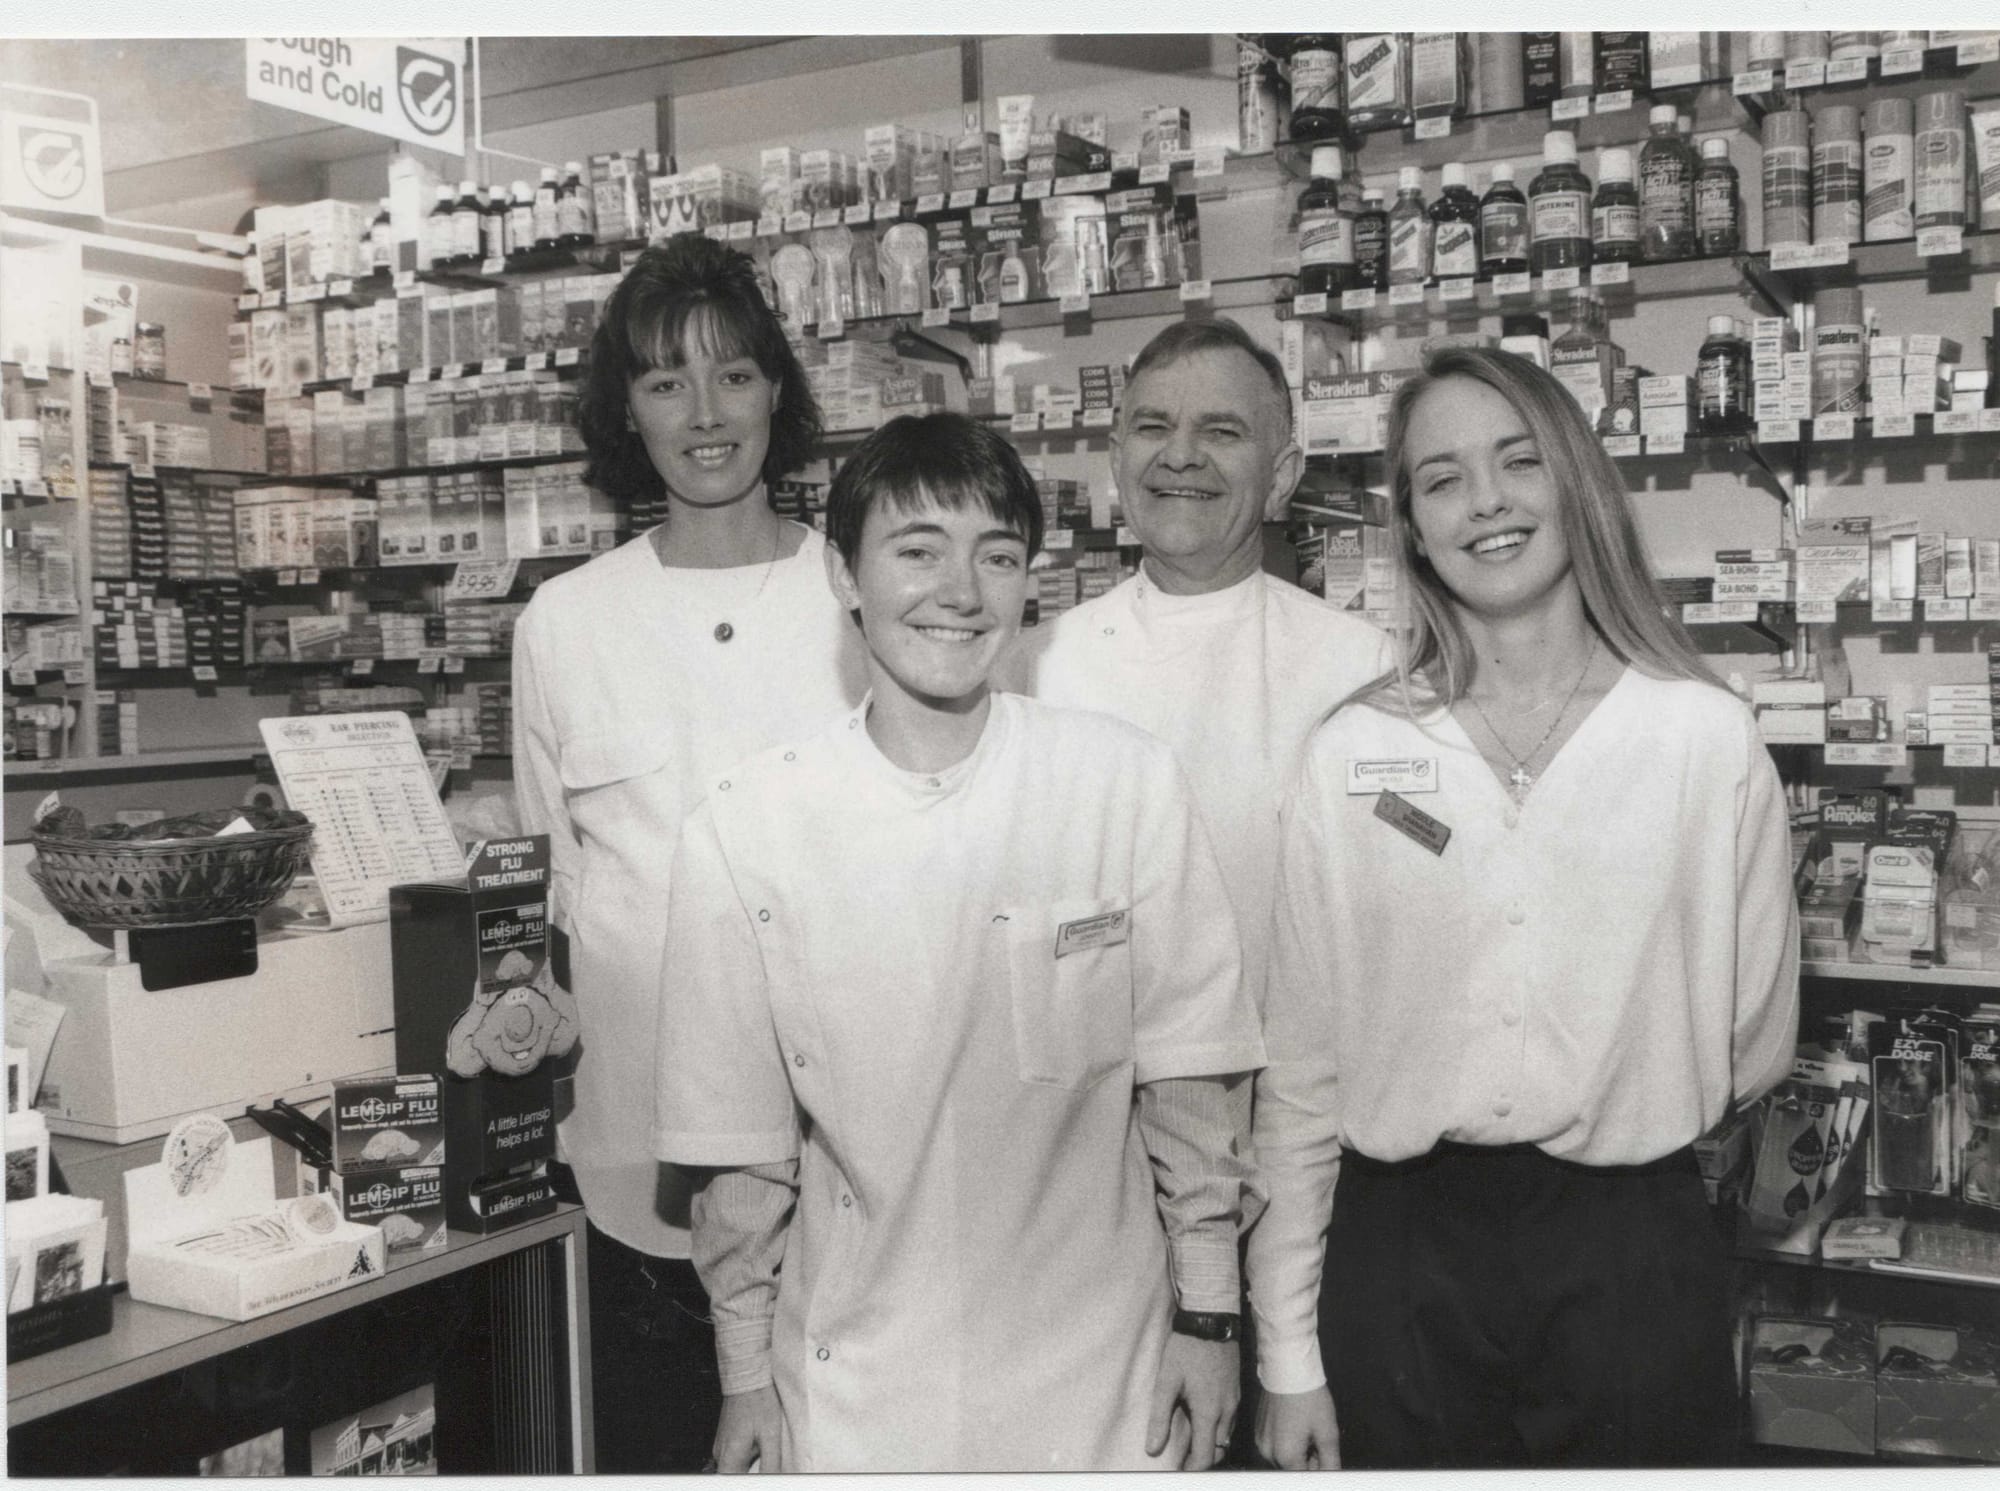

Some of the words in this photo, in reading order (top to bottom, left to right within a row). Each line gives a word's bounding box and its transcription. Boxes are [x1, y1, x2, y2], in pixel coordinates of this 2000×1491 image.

[262, 38, 352, 68] ough
[260, 60, 313, 94] and
[322, 72, 383, 114] Cold
[1536, 201, 1575, 211] LISTERINE
[1308, 378, 1369, 399] Steradent
[354, 720, 400, 731] PIERCING
[1360, 766, 1410, 776] Guardian
[1824, 805, 1877, 826] Amplex
[486, 841, 535, 858] STRONG
[501, 857, 522, 871] FLU
[477, 868, 545, 888] TREATMENT
[481, 922, 523, 941] LEMSIP
[526, 921, 544, 933] FLU
[1893, 1038, 1920, 1050] EZY
[1971, 1043, 1991, 1053] EZY
[1891, 1049, 1934, 1062] DOSE
[1970, 1051, 1997, 1062] DOSE
[341, 1100, 404, 1119] LEMSIP
[408, 1099, 438, 1113] FLU
[487, 1120, 496, 1135] A
[497, 1115, 519, 1132] little
[519, 1107, 551, 1127] Lemsip
[496, 1132, 522, 1150] helps
[349, 1185, 409, 1206] LEMSIP
[412, 1181, 440, 1195] FLU
[489, 1198, 525, 1216] LEMSIP
[527, 1189, 543, 1205] FLU
